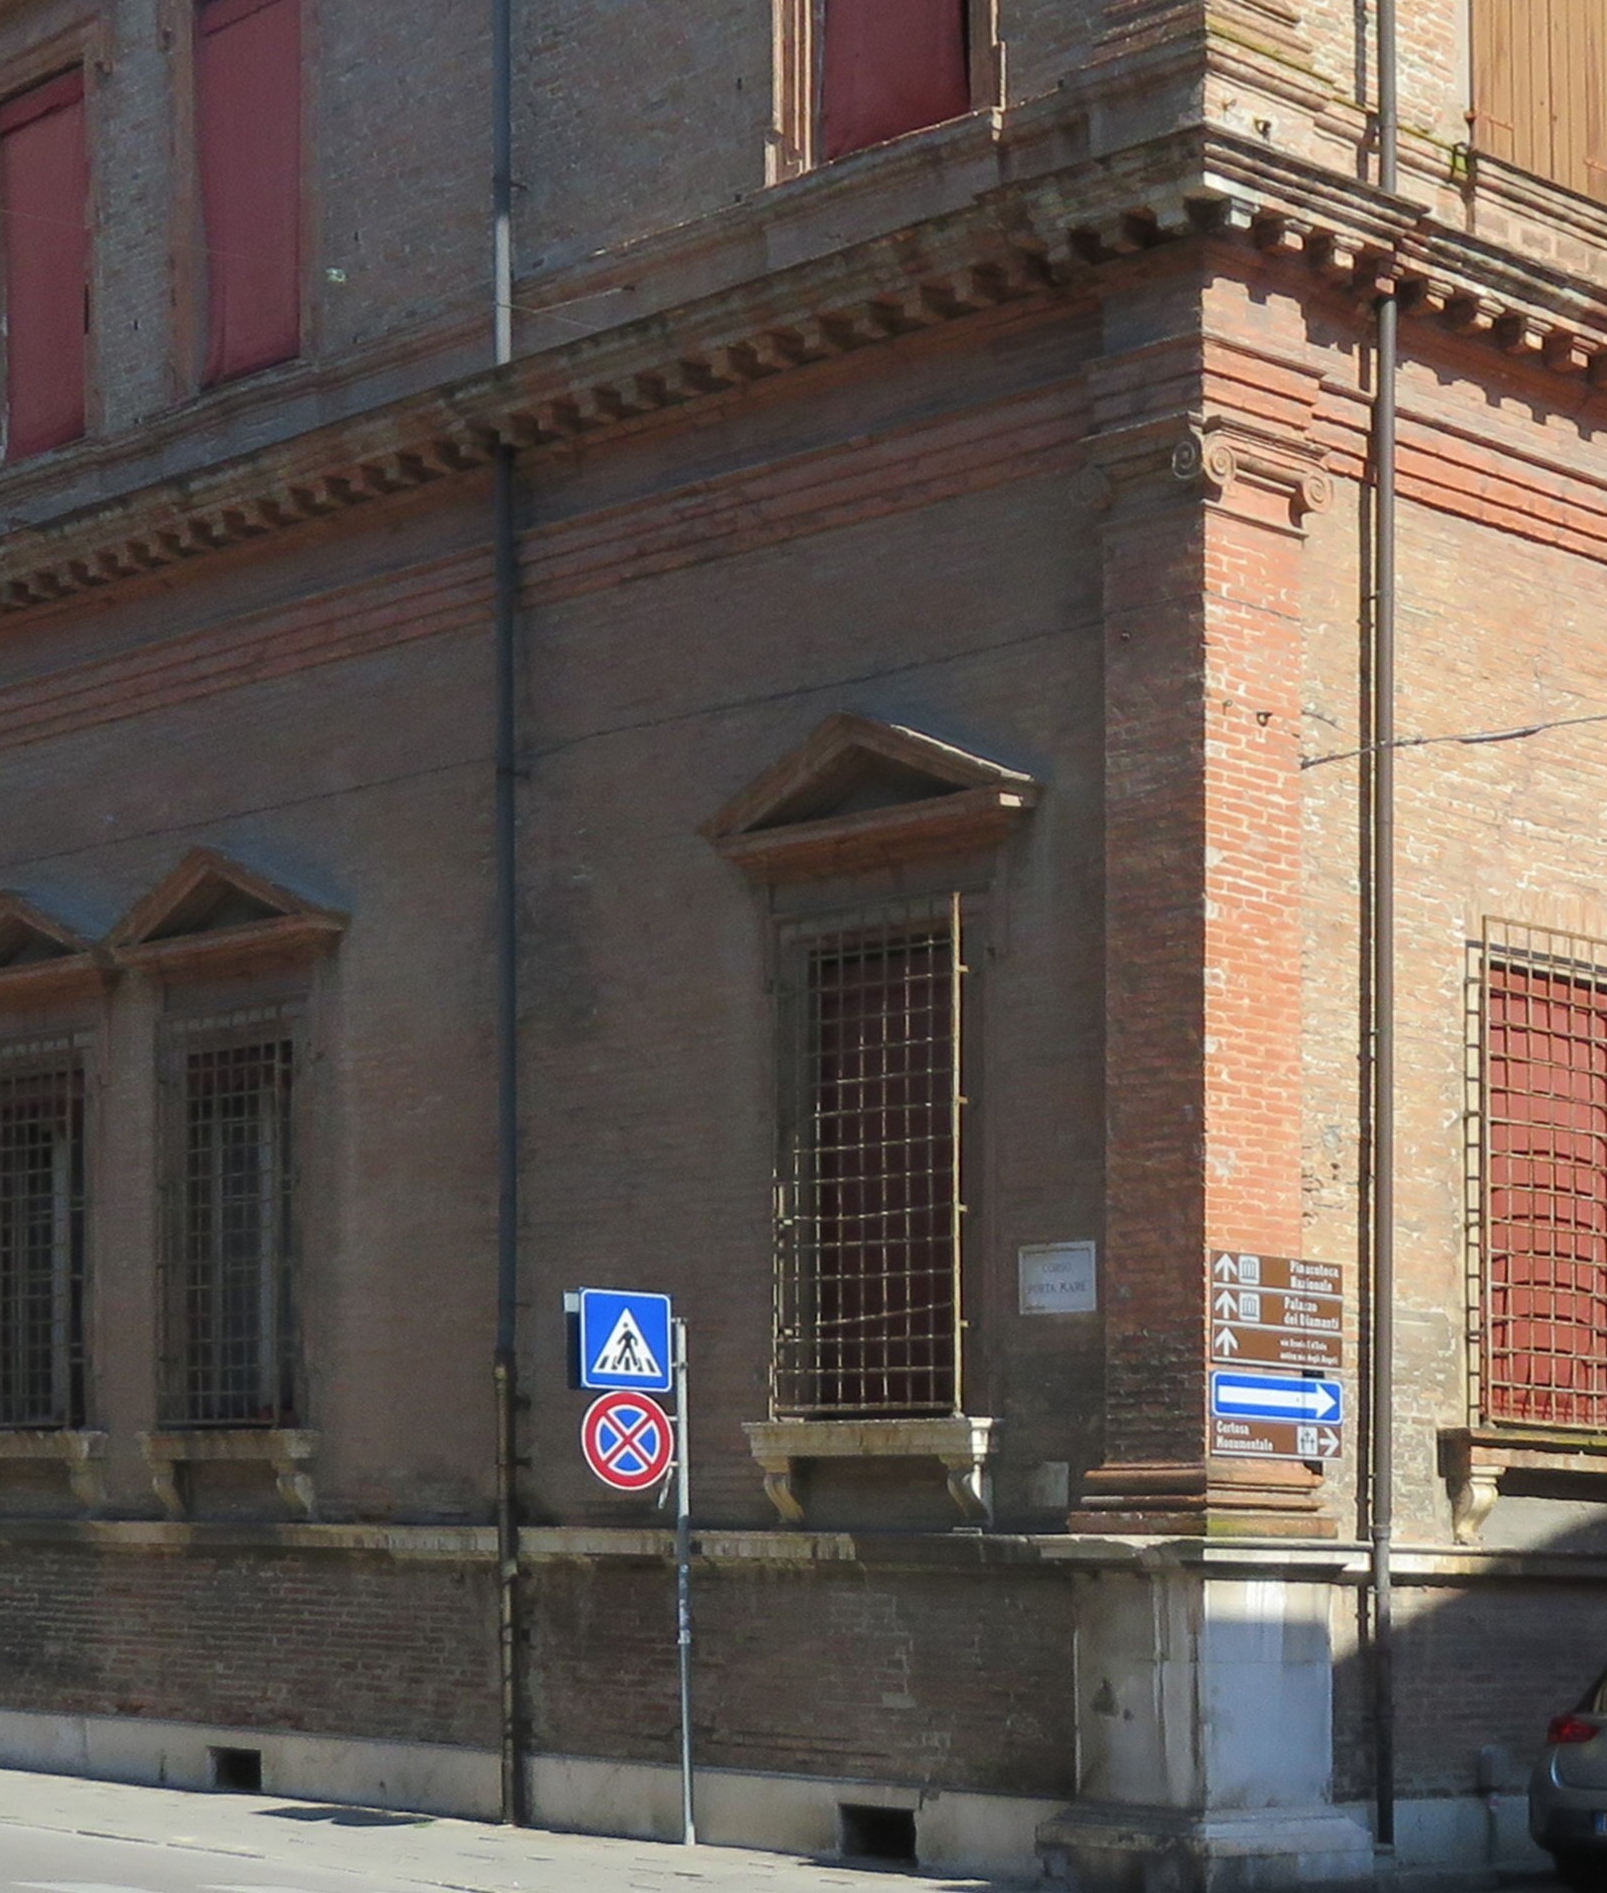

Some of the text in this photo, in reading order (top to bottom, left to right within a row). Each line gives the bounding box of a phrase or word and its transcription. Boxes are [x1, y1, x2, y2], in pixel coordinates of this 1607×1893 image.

[1290, 1260, 1339, 1278] Pinacoteca
[1290, 1276, 1333, 1291] Nazionale
[1285, 1296, 1318, 1312] Palazzo
[1284, 1312, 1339, 1329] dei Diamanti
[1217, 1420, 1250, 1435] Certosa
[1217, 1435, 1274, 1451] Monumentale
